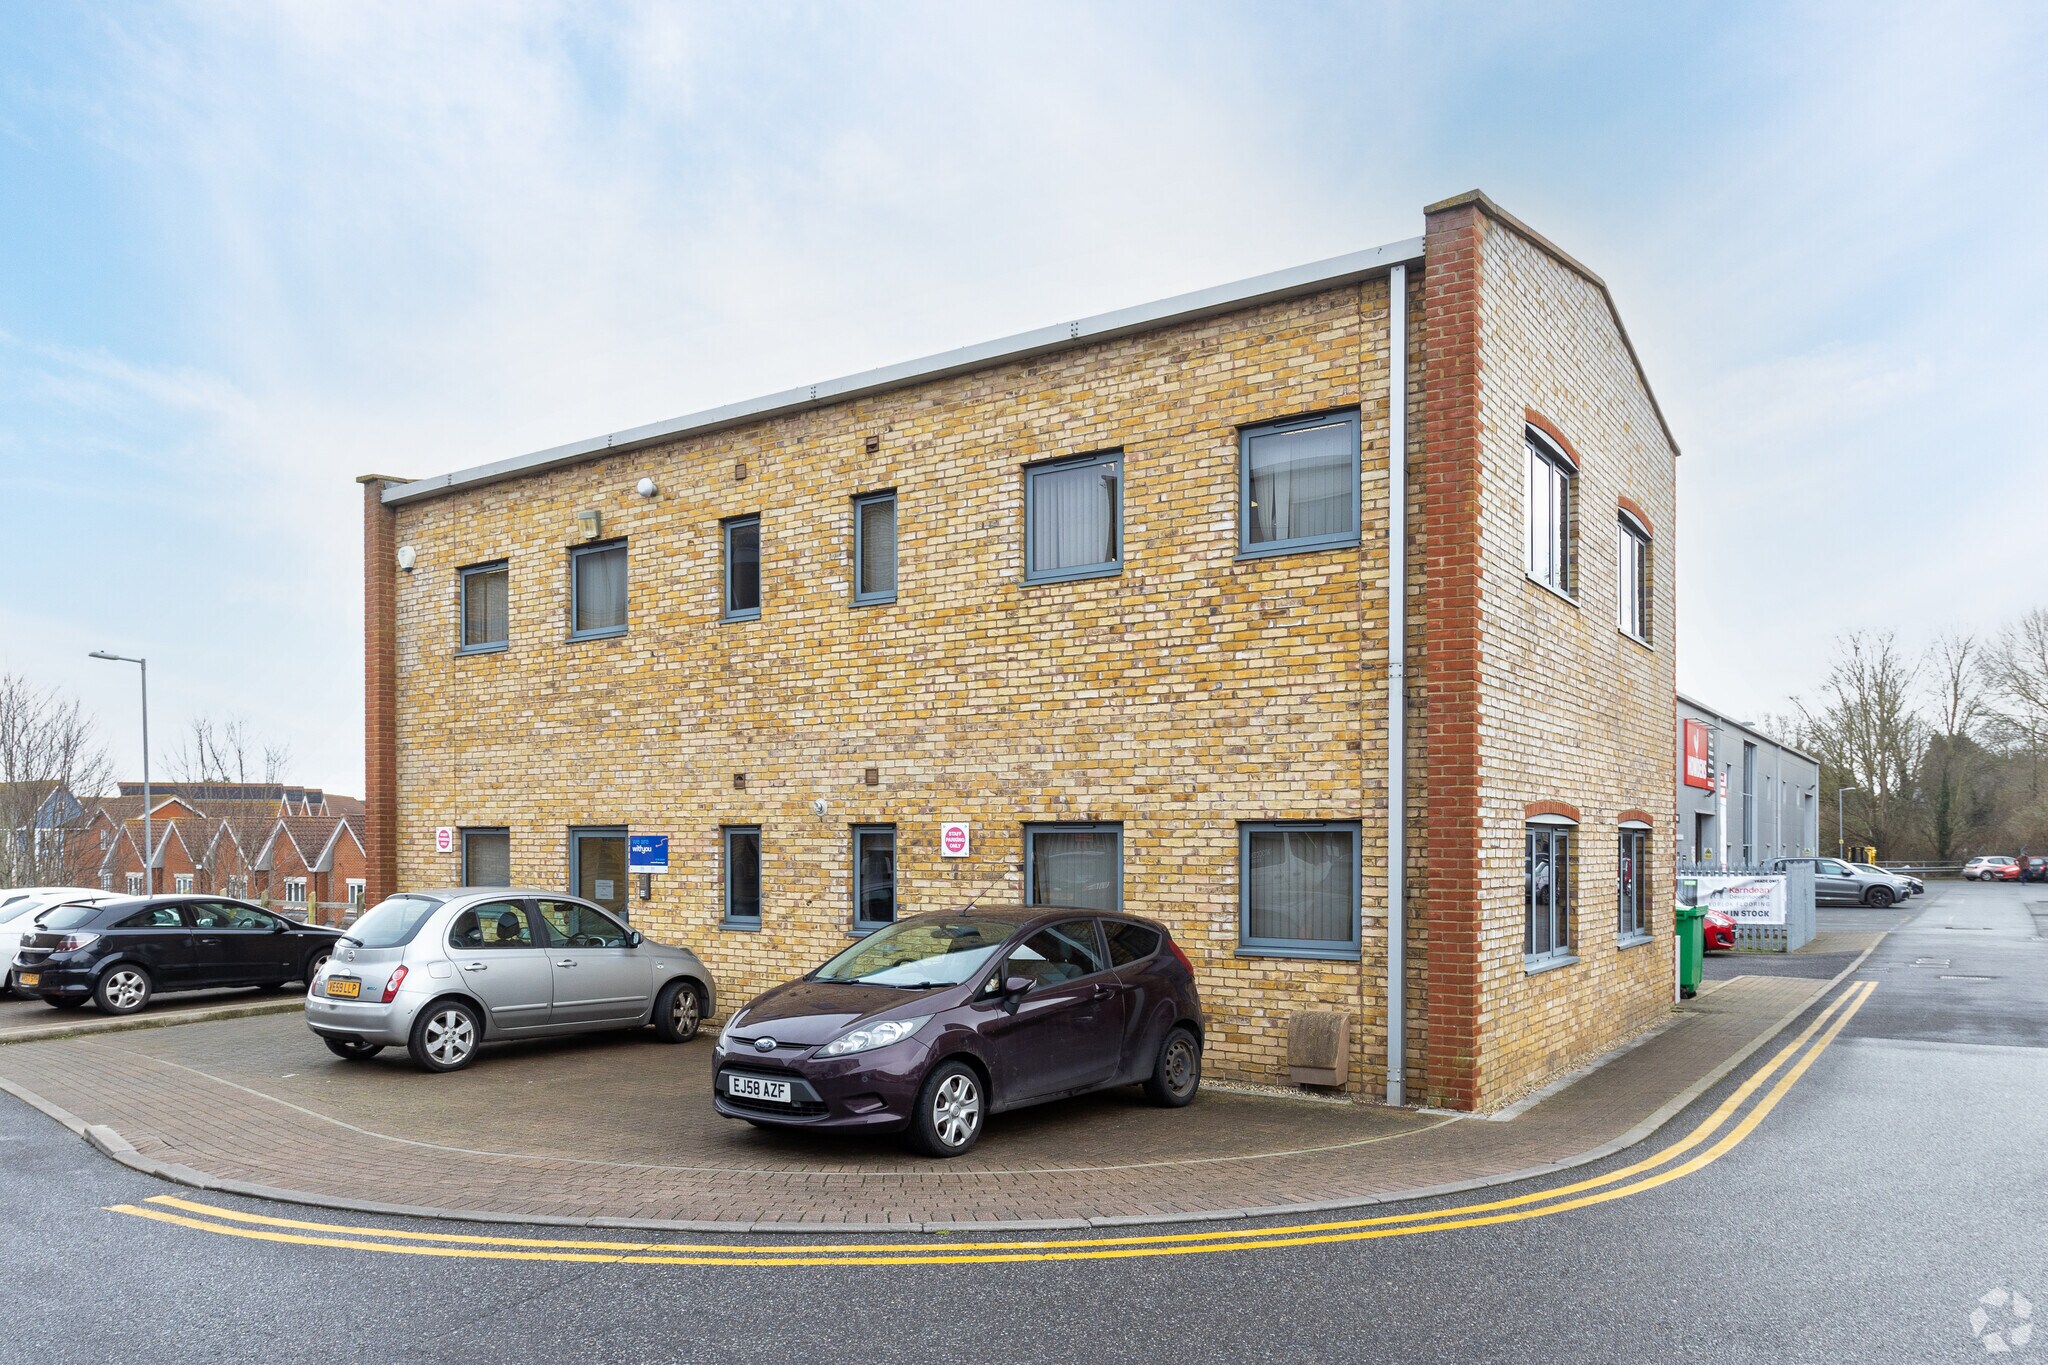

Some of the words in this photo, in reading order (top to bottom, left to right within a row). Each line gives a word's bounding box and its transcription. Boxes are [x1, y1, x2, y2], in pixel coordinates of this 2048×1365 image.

[344, 984, 356, 993] LLP
[734, 1078, 760, 1095] EJ58
[764, 1082, 785, 1098] AZF
